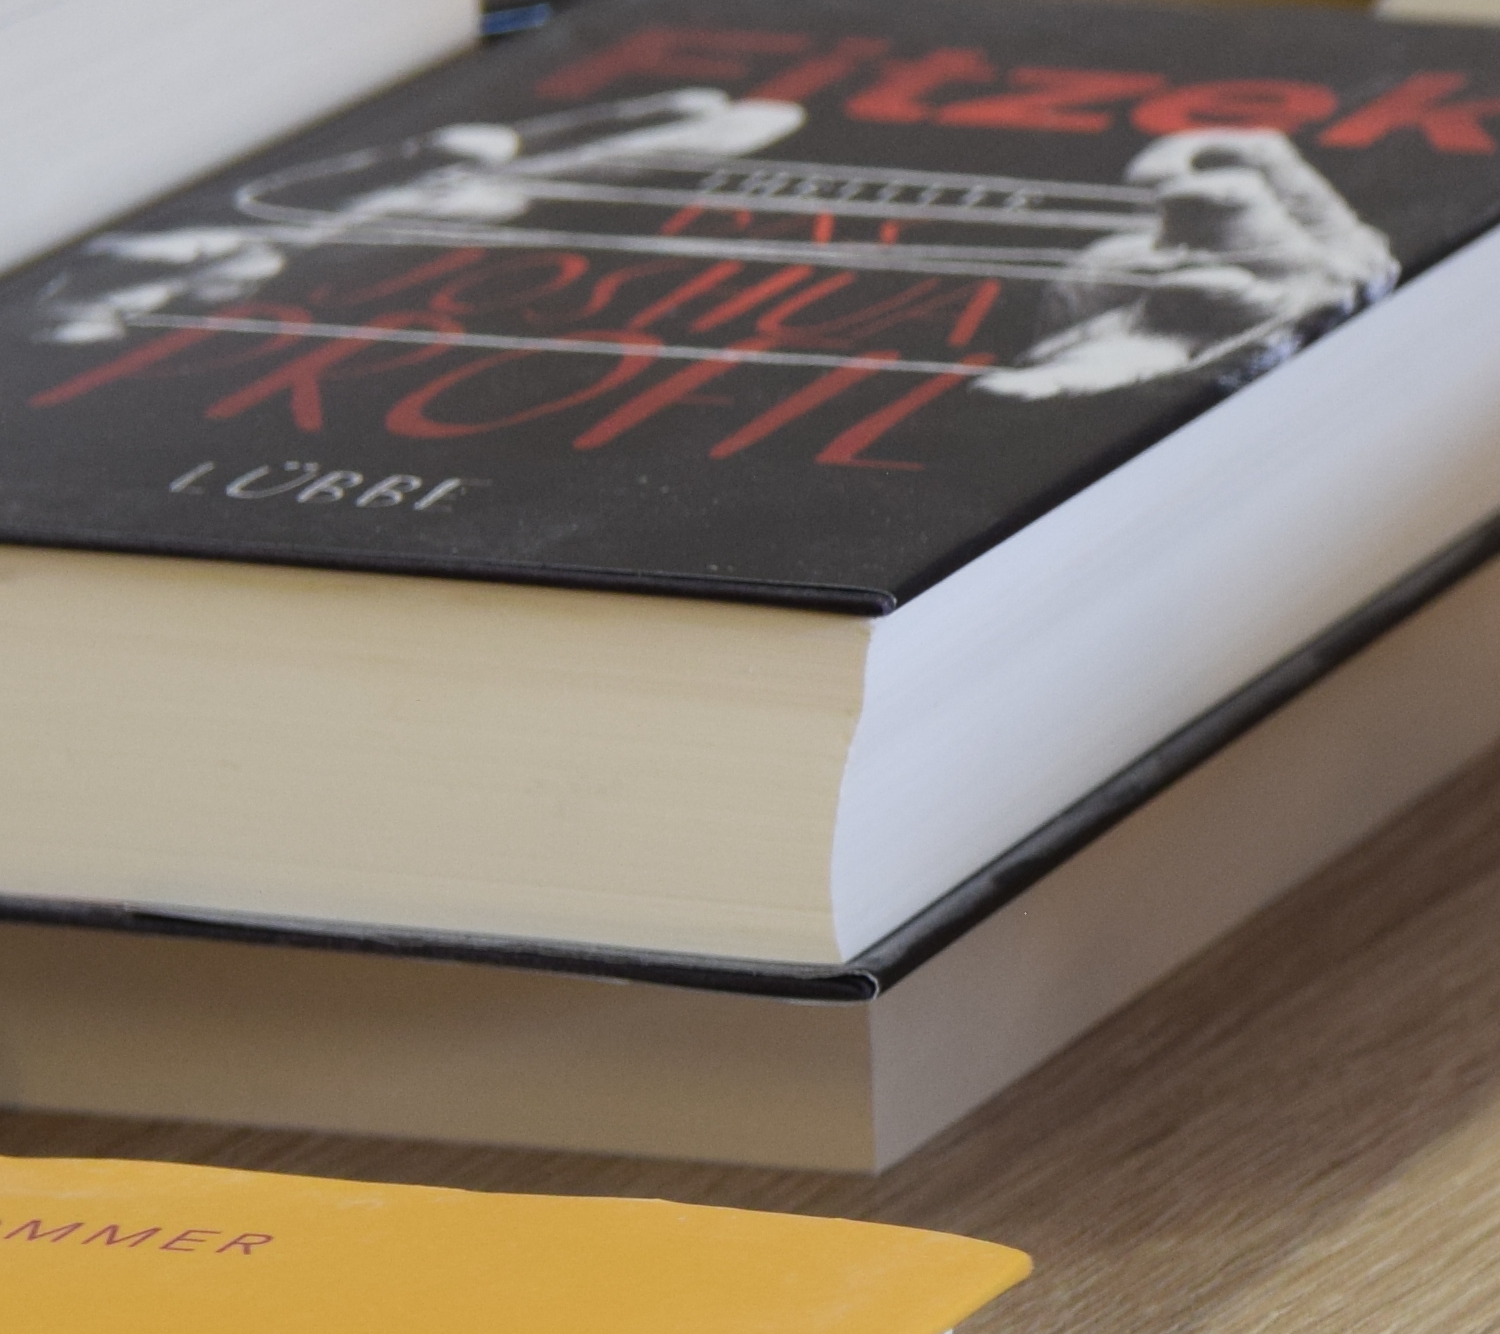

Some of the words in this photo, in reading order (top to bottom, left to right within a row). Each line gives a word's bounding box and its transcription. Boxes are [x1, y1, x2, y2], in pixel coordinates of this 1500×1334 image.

[30, 302, 998, 469] PROFIL
[170, 461, 490, 512] LÜBBE
[0, 1218, 274, 1255] MMER
